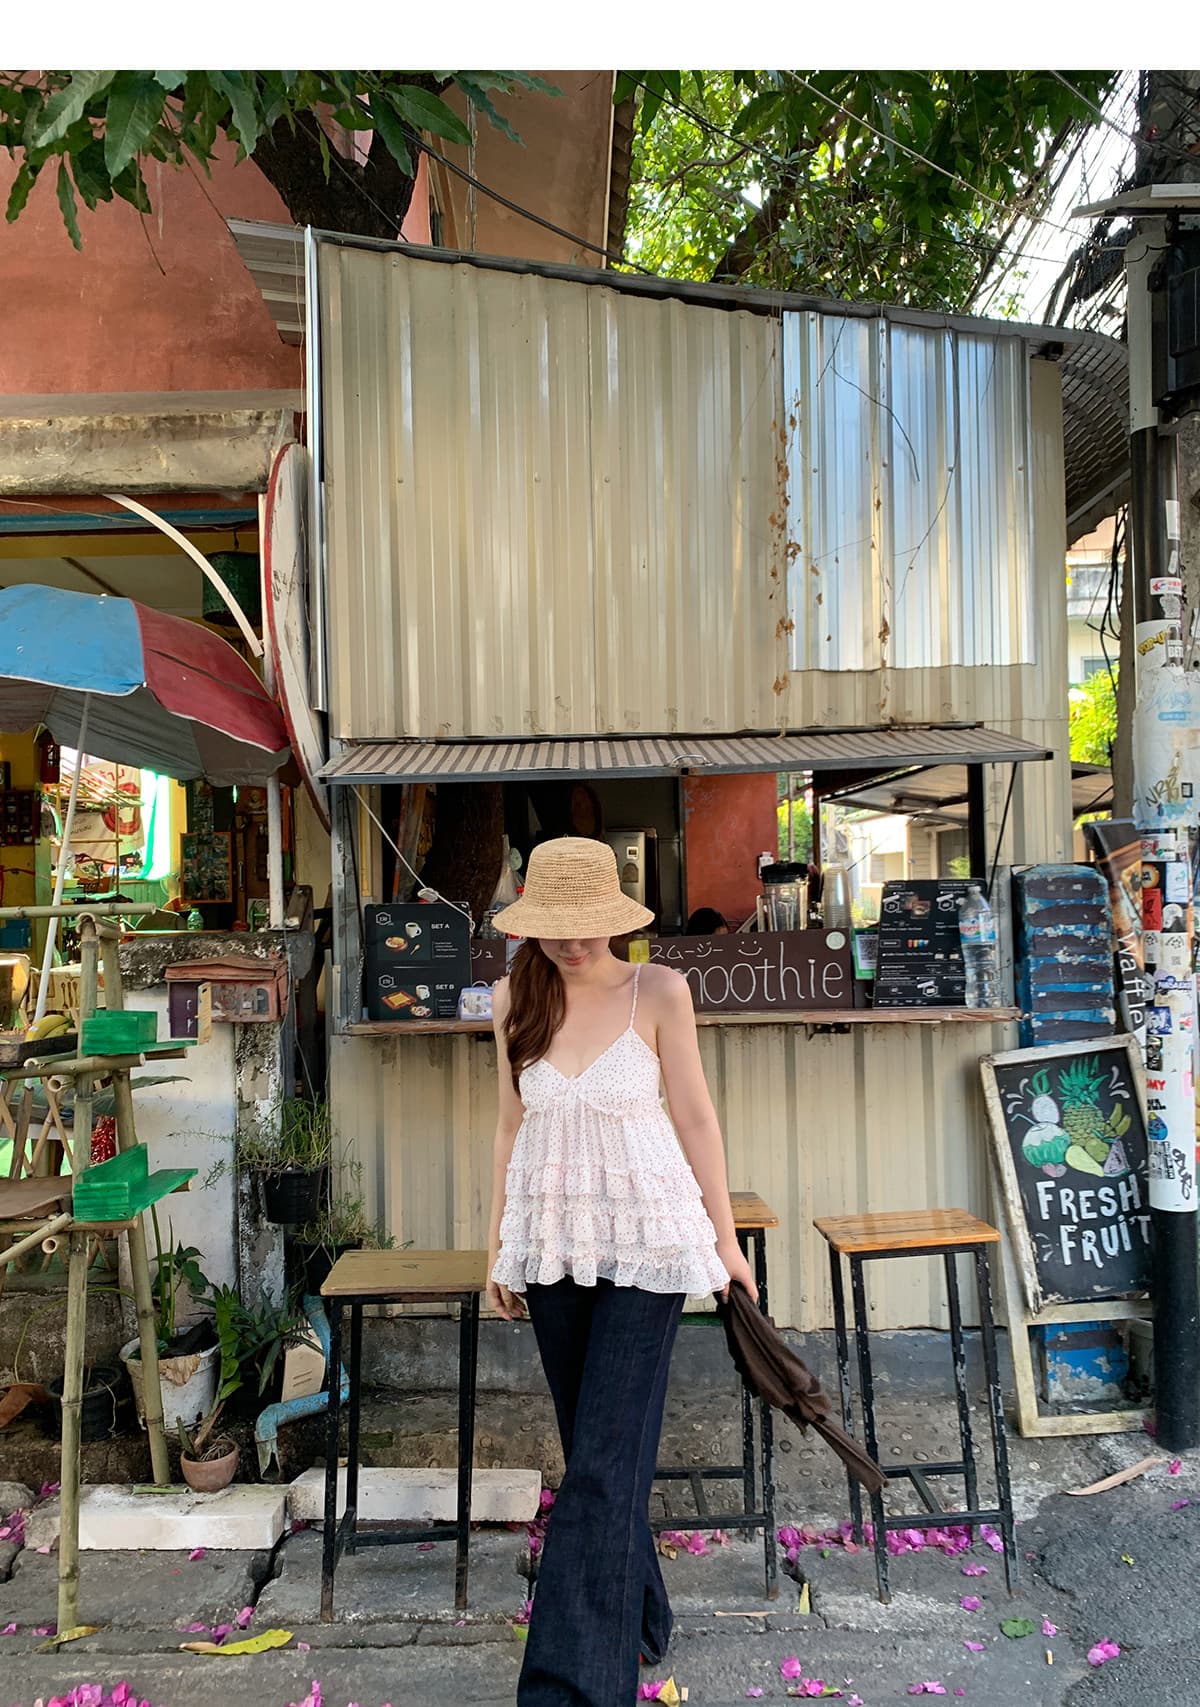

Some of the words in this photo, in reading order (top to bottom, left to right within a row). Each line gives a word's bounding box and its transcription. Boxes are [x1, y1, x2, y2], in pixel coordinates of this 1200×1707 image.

[650, 941, 724, 960] スムージー
[677, 941, 844, 1005] moothie
[1117, 932, 1146, 1024] Waffle
[1035, 1173, 1142, 1222] FRESH
